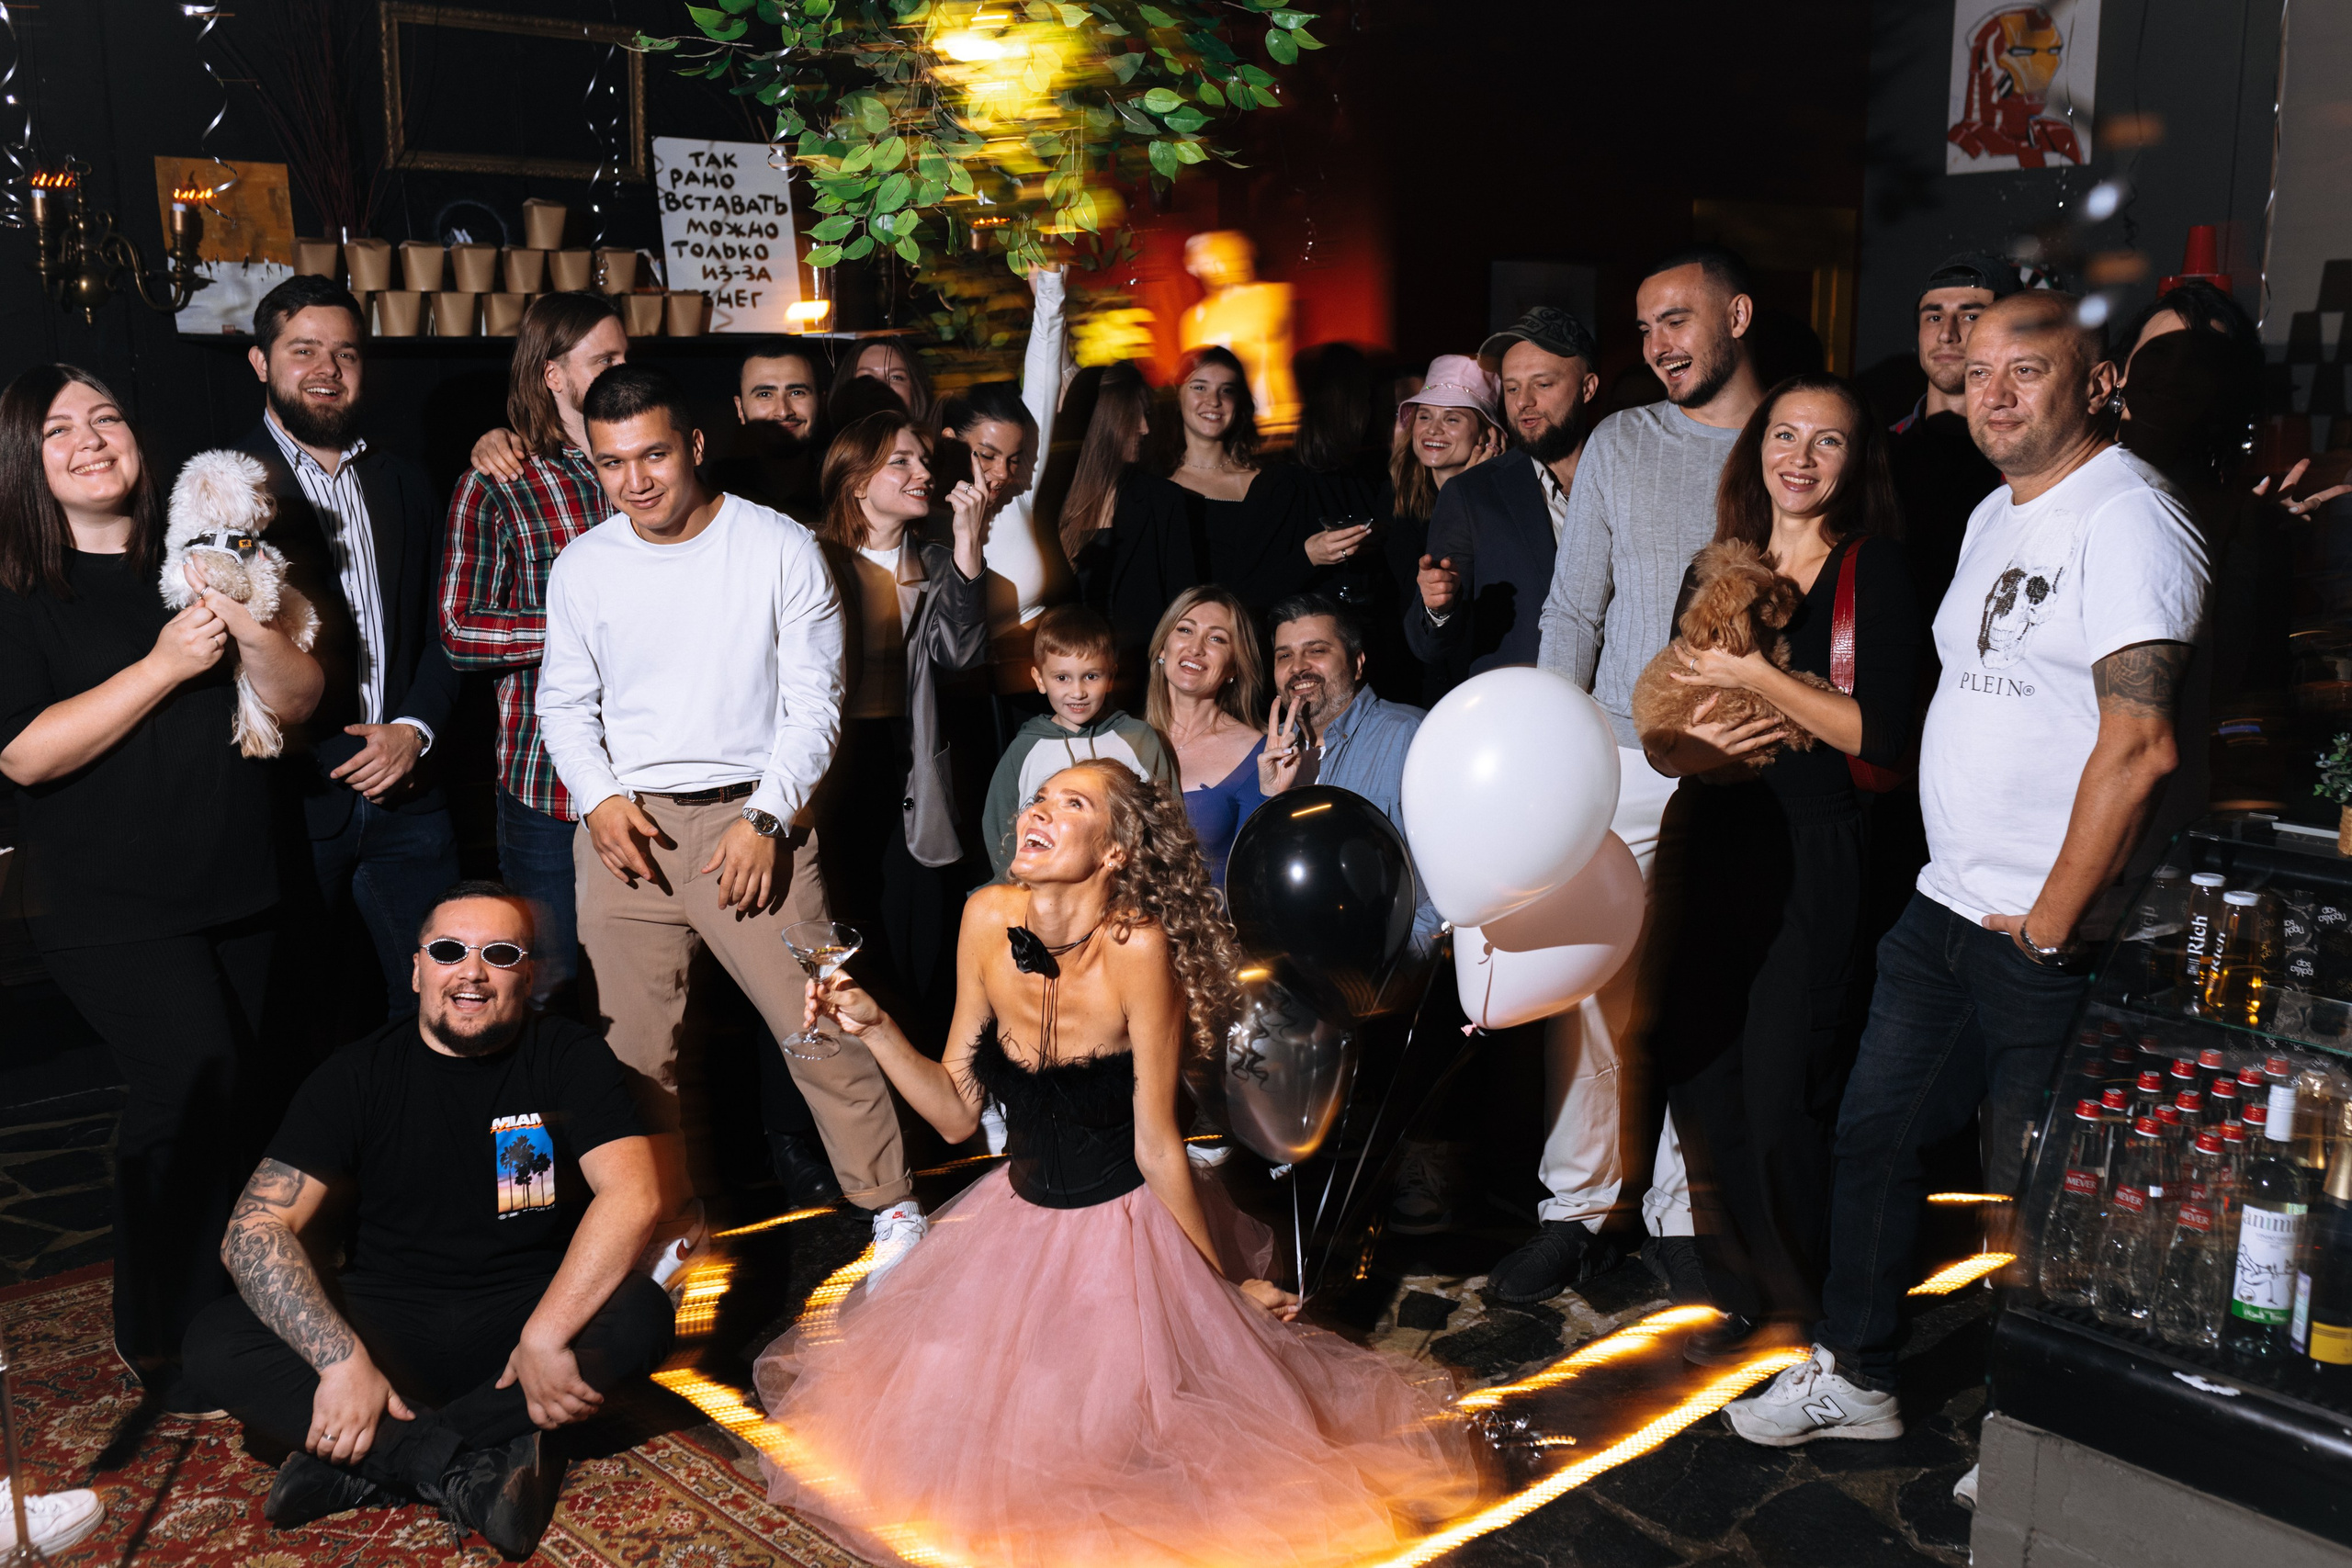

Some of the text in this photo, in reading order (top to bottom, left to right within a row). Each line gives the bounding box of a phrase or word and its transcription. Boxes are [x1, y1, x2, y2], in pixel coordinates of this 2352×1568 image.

[688, 152, 738, 169] ТАК
[670, 168, 734, 189] РАНО
[664, 191, 788, 216] ВСТАВАТЬ
[686, 218, 779, 239] МОЖНО
[671, 241, 769, 261] ТОЛЬКО
[702, 265, 772, 283] ИЗ-ЗА
[702, 289, 763, 309] НЕГ
[2188, 915, 2208, 955] Rich
[2066, 1177, 2097, 1190] MEVER
[1803, 1394, 1847, 1426] N
